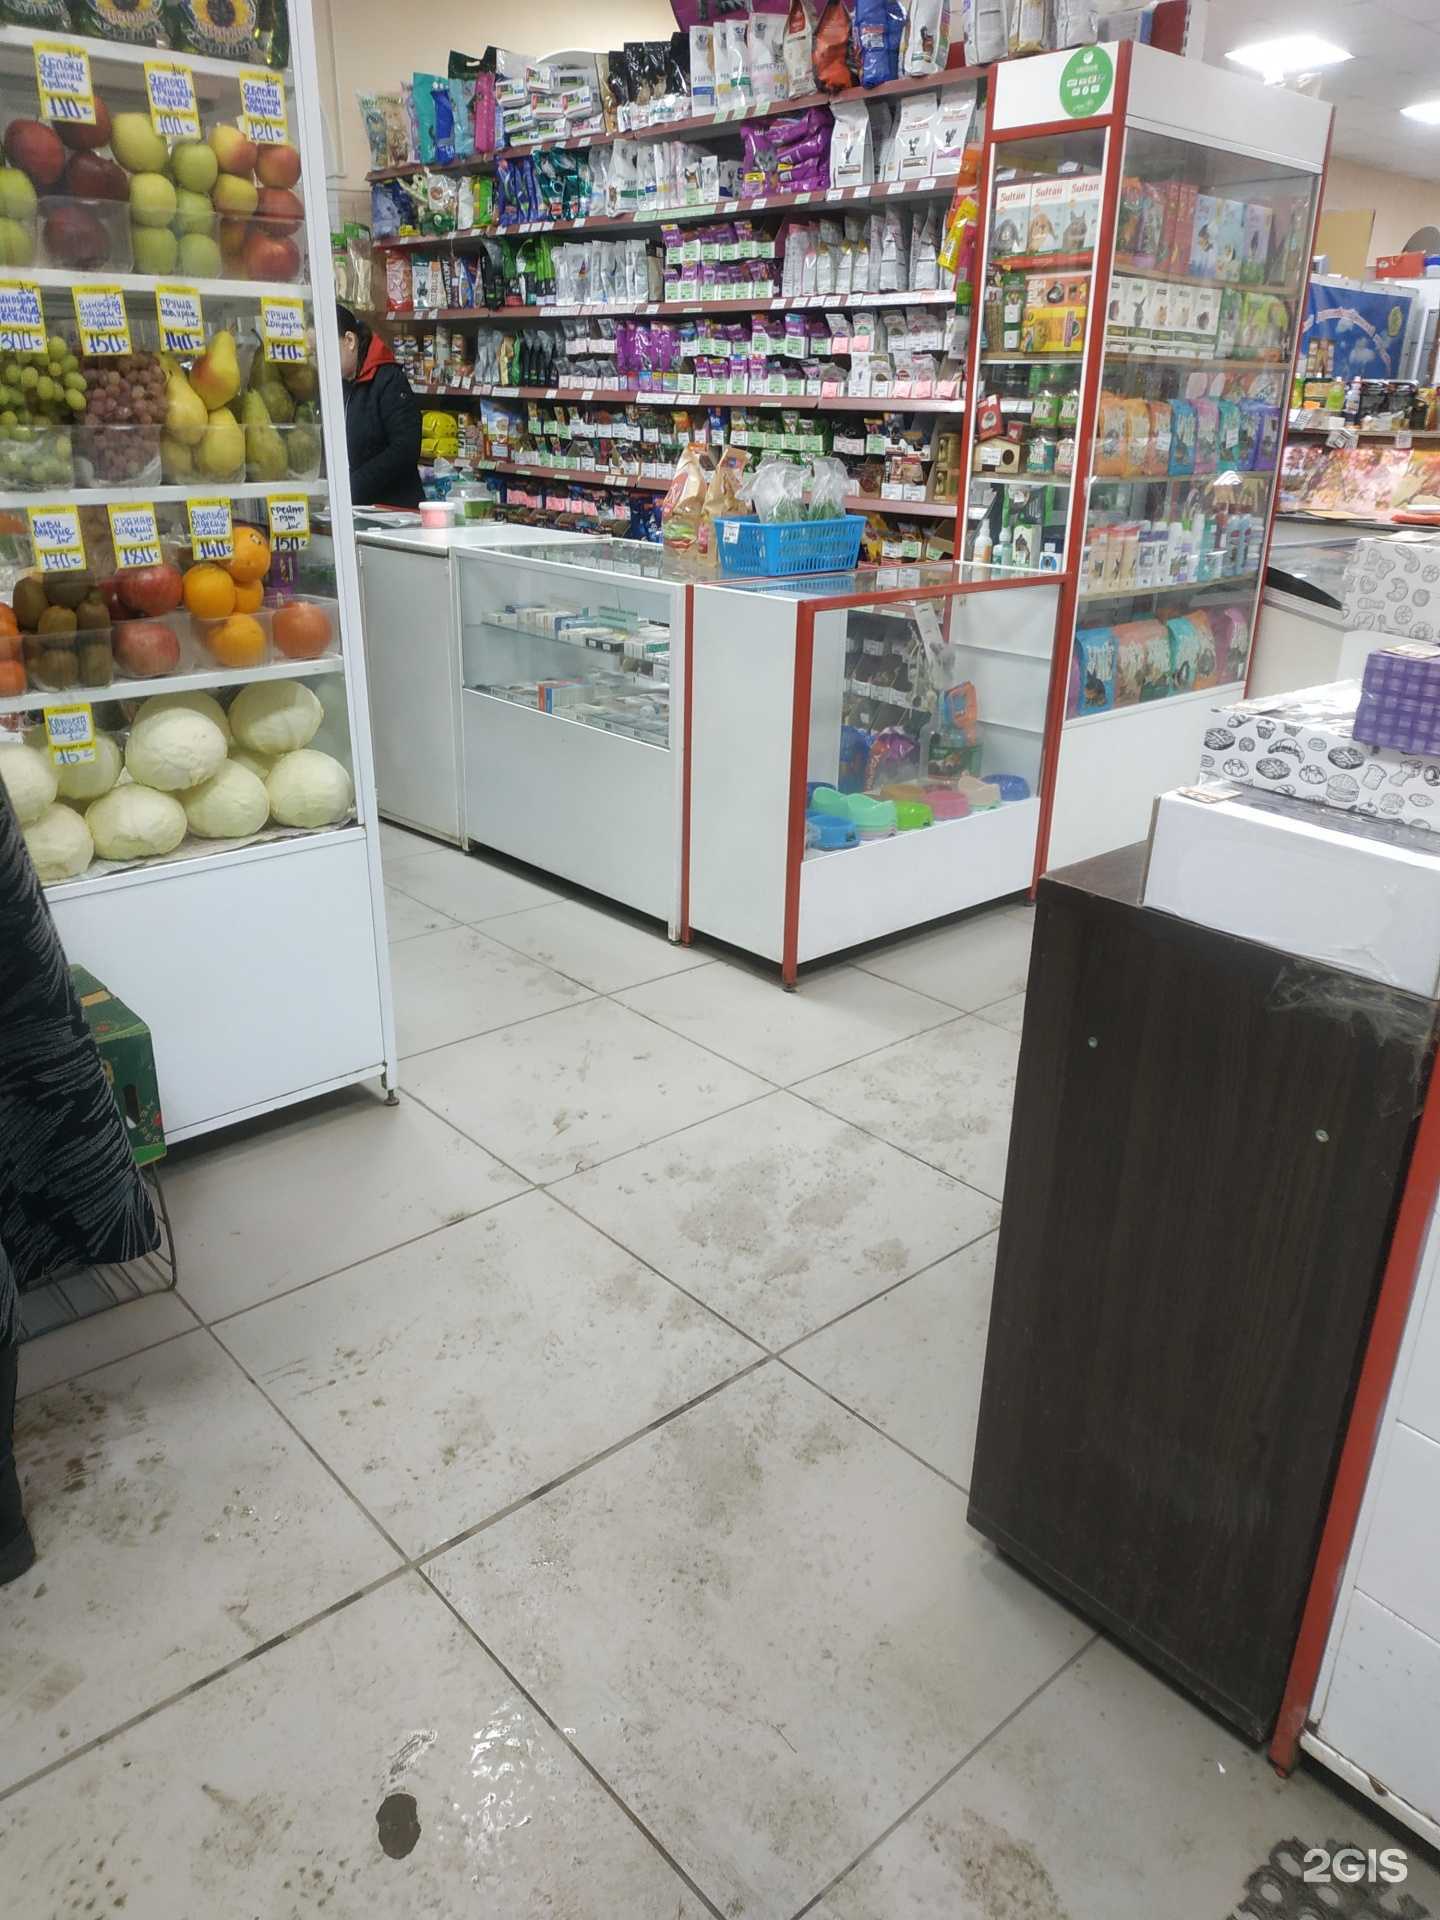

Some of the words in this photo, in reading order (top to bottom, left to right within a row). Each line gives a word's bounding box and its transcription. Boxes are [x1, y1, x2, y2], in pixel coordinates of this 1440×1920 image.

[250, 120, 274, 141] 120
[1035, 185, 1063, 197] Sultan
[1072, 182, 1100, 193] Sultan
[200, 540, 228, 560] 140
[274, 536, 299, 552] 150
[43, 551, 71, 571] 170
[123, 547, 152, 567] 180
